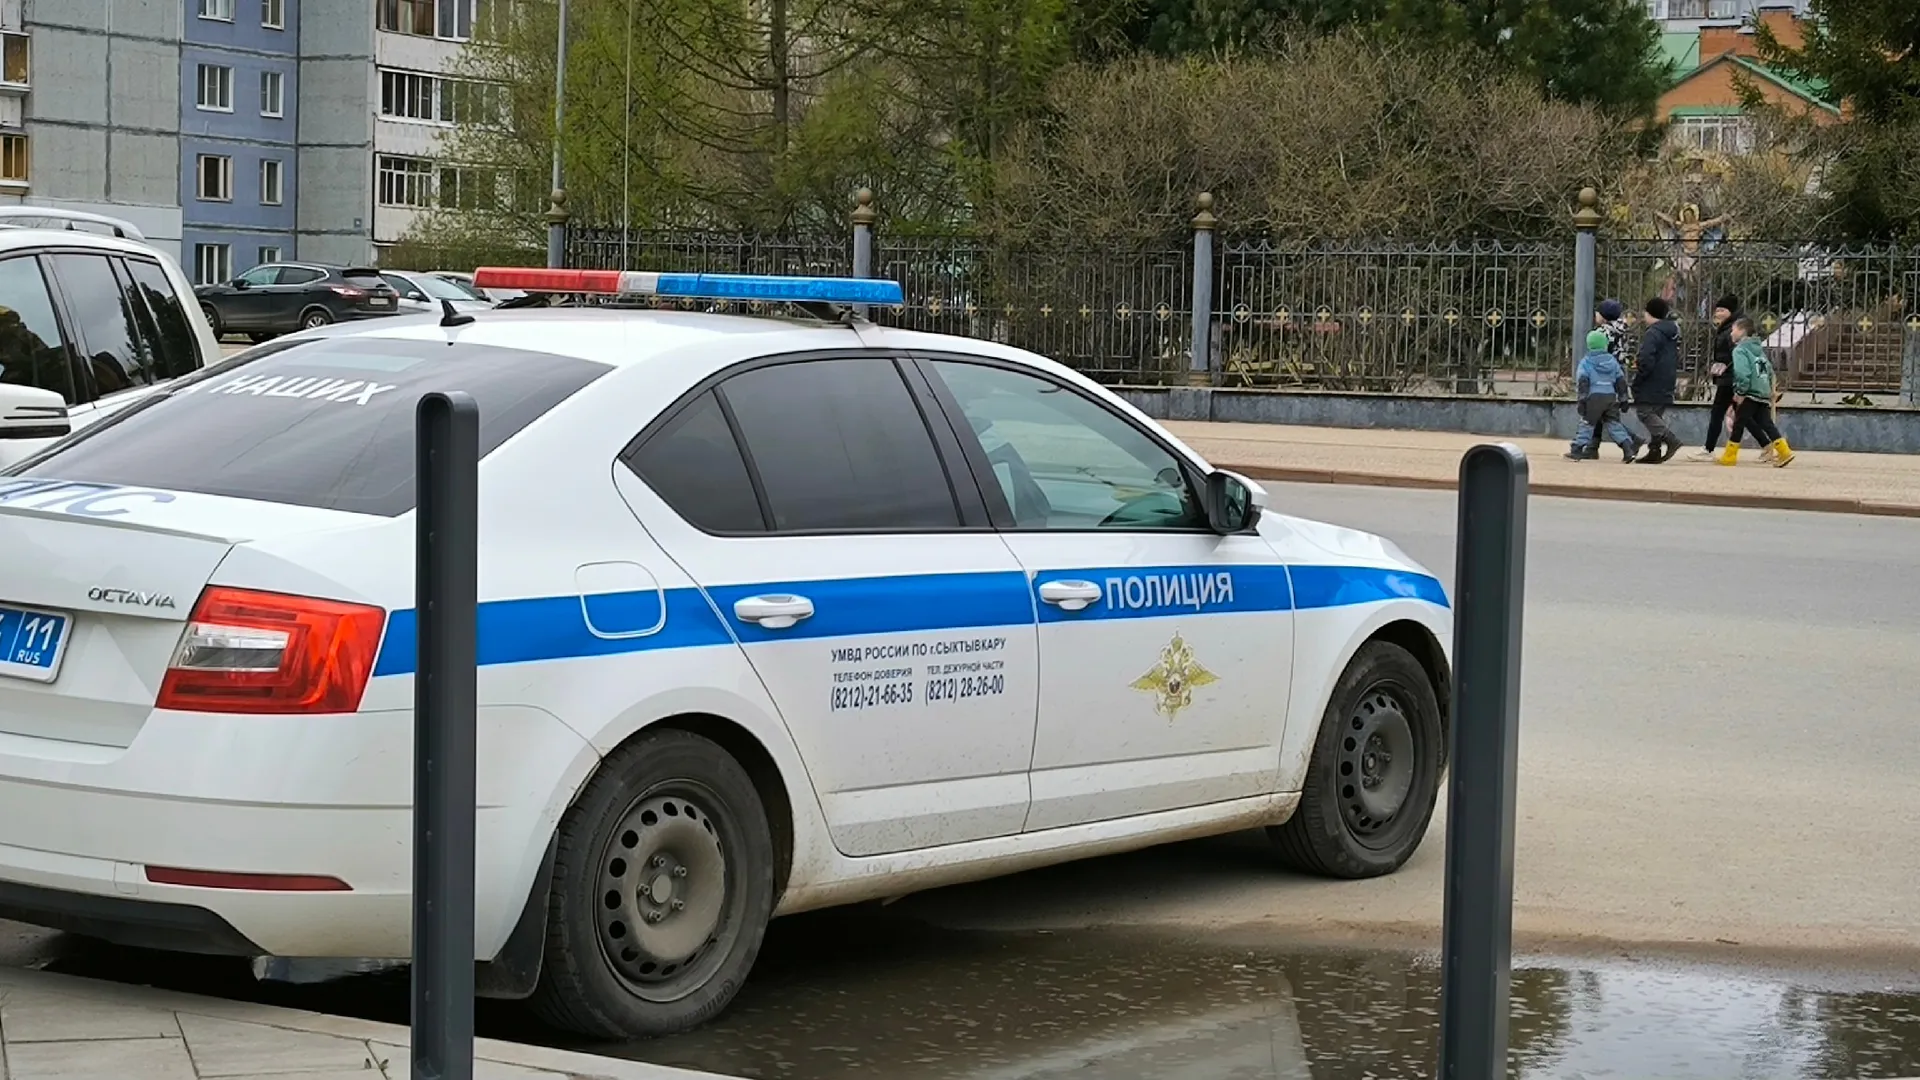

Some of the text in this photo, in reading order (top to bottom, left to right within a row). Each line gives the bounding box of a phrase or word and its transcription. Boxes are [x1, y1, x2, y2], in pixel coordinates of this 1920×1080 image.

[208, 374, 397, 406] НАШИХ
[88, 587, 175, 609] OCTAVIA
[1105, 572, 1234, 611] ПОЛИЦИЯ
[25, 616, 56, 651] 11
[16, 649, 41, 665] RUS
[831, 647, 862, 663] УМВД
[865, 645, 909, 660] РОССИИ
[912, 643, 928, 656] ПО
[833, 667, 913, 683] ТЕЛЕФОН ДОВЕРИЯ
[943, 661, 981, 675] ДЕЖУРНОЙ
[982, 660, 1004, 671] ЧАСТИ
[925, 674, 1004, 707] (8212) 28-26-00
